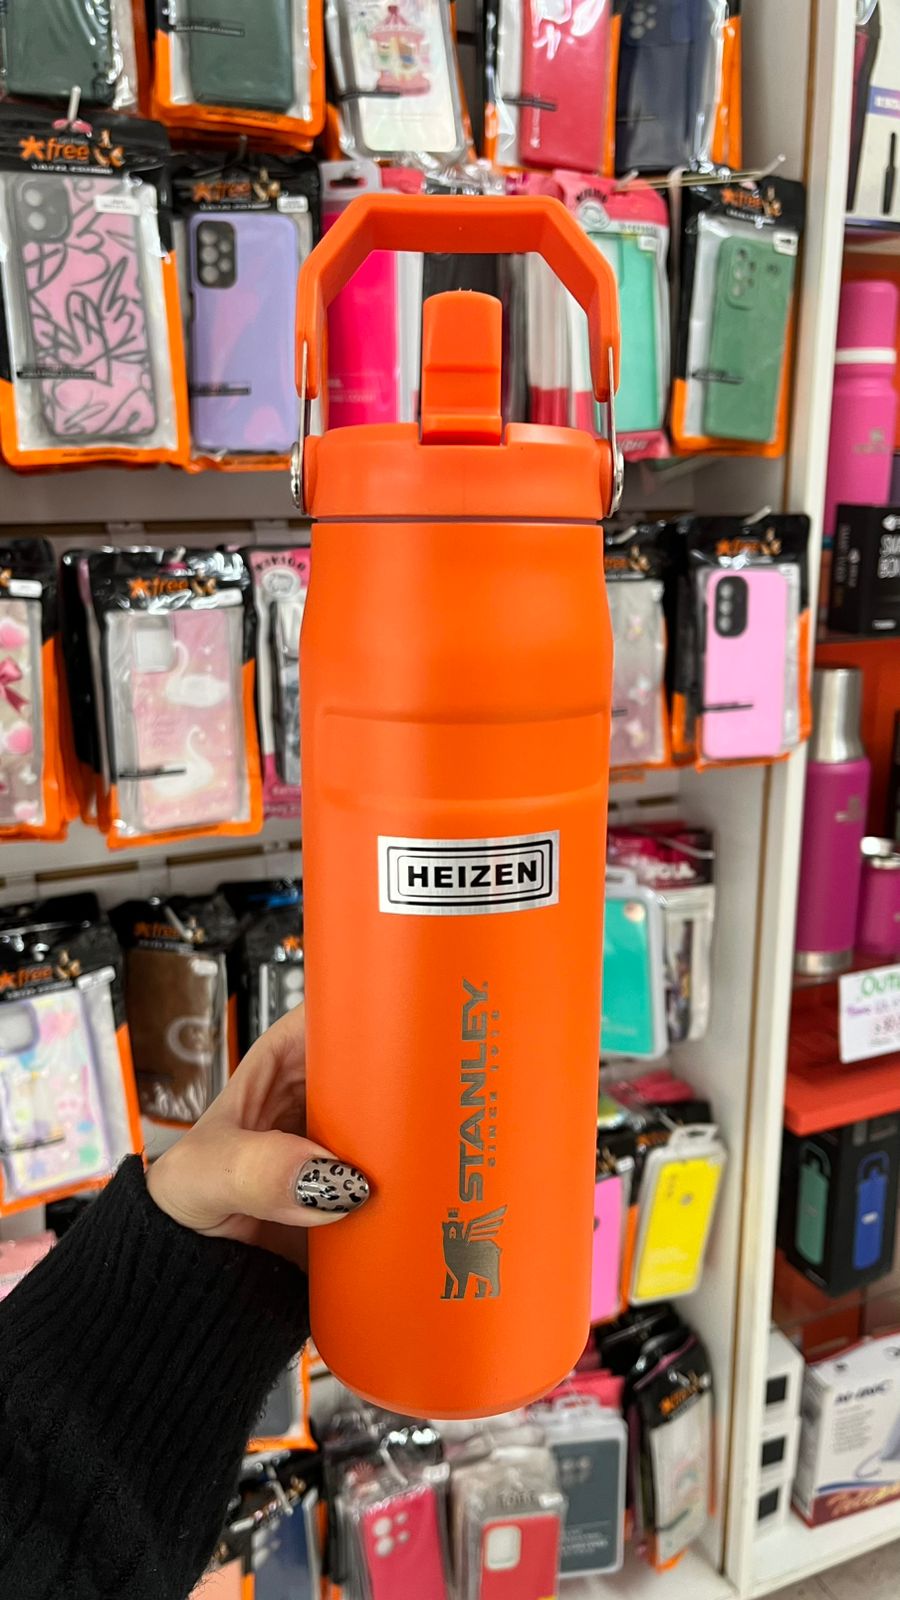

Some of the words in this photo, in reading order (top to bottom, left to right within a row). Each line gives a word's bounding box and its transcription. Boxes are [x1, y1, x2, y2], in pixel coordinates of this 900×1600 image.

[46, 136, 90, 161] free
[151, 577, 189, 597] free
[407, 860, 537, 888] HEIZEN
[458, 976, 489, 1203] STANLEY
[487, 1090, 498, 1168] SINCE
